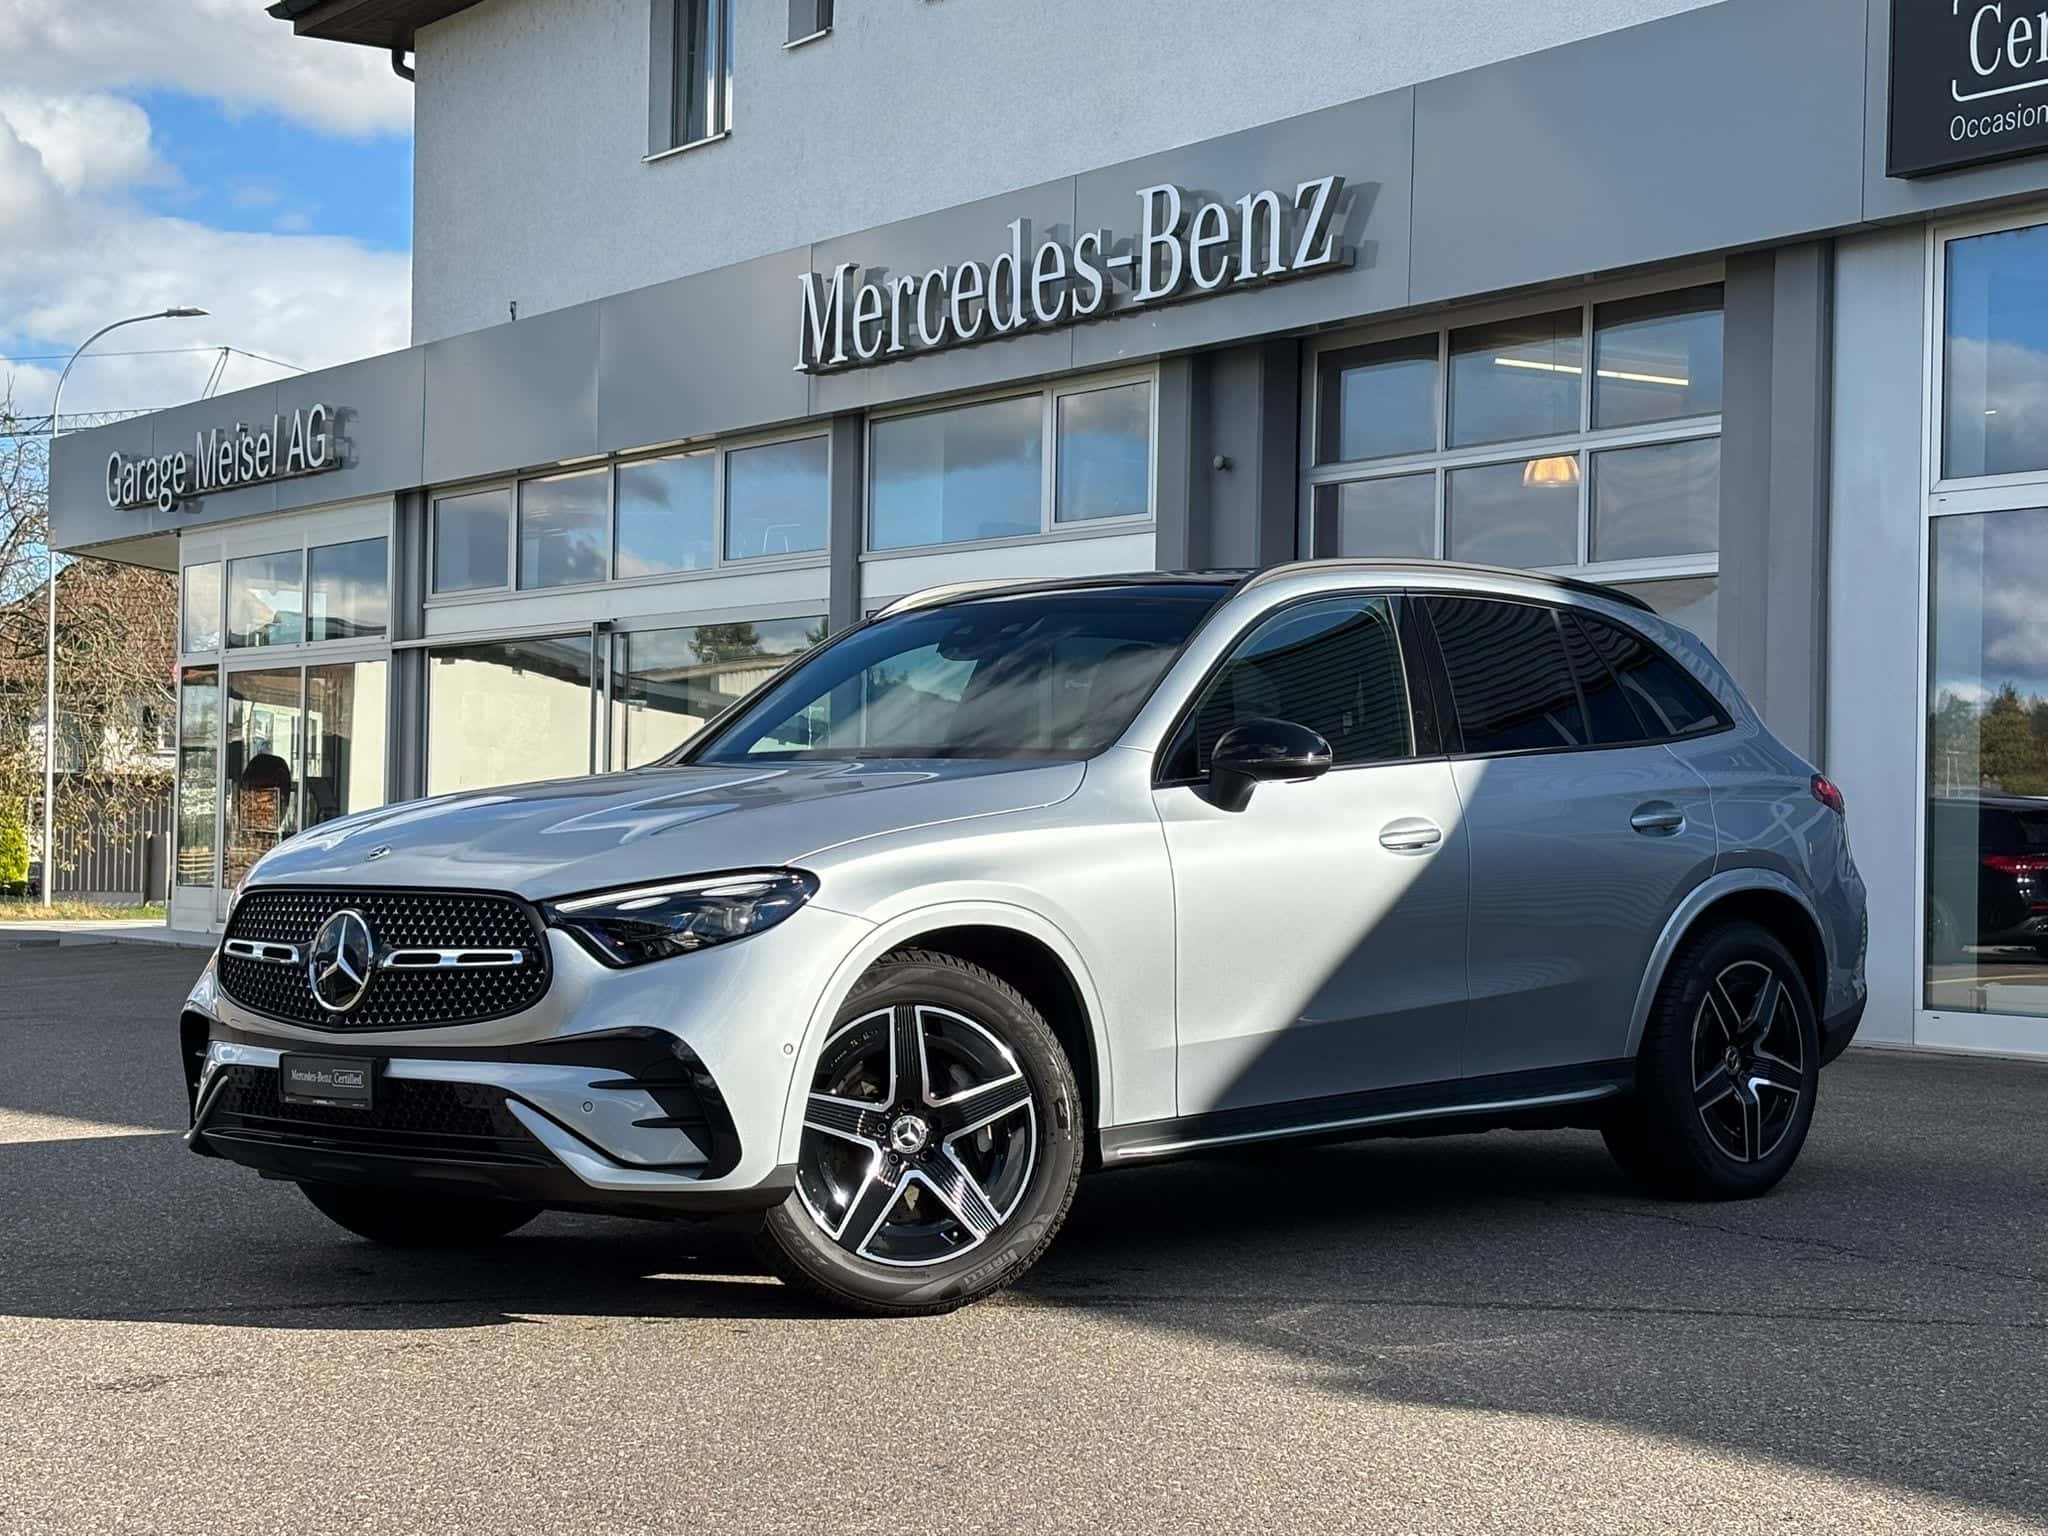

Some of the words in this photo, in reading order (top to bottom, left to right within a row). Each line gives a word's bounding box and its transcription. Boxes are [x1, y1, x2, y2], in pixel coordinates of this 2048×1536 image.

[1950, 103, 2048, 141] Occasion
[793, 175, 1346, 371] Mercedes-Benz
[106, 450, 186, 513] Garage
[195, 413, 279, 490] Meisel
[286, 402, 327, 473] AG
[290, 1069, 332, 1084] Mercedes-Benz
[334, 1073, 362, 1085] Certified
